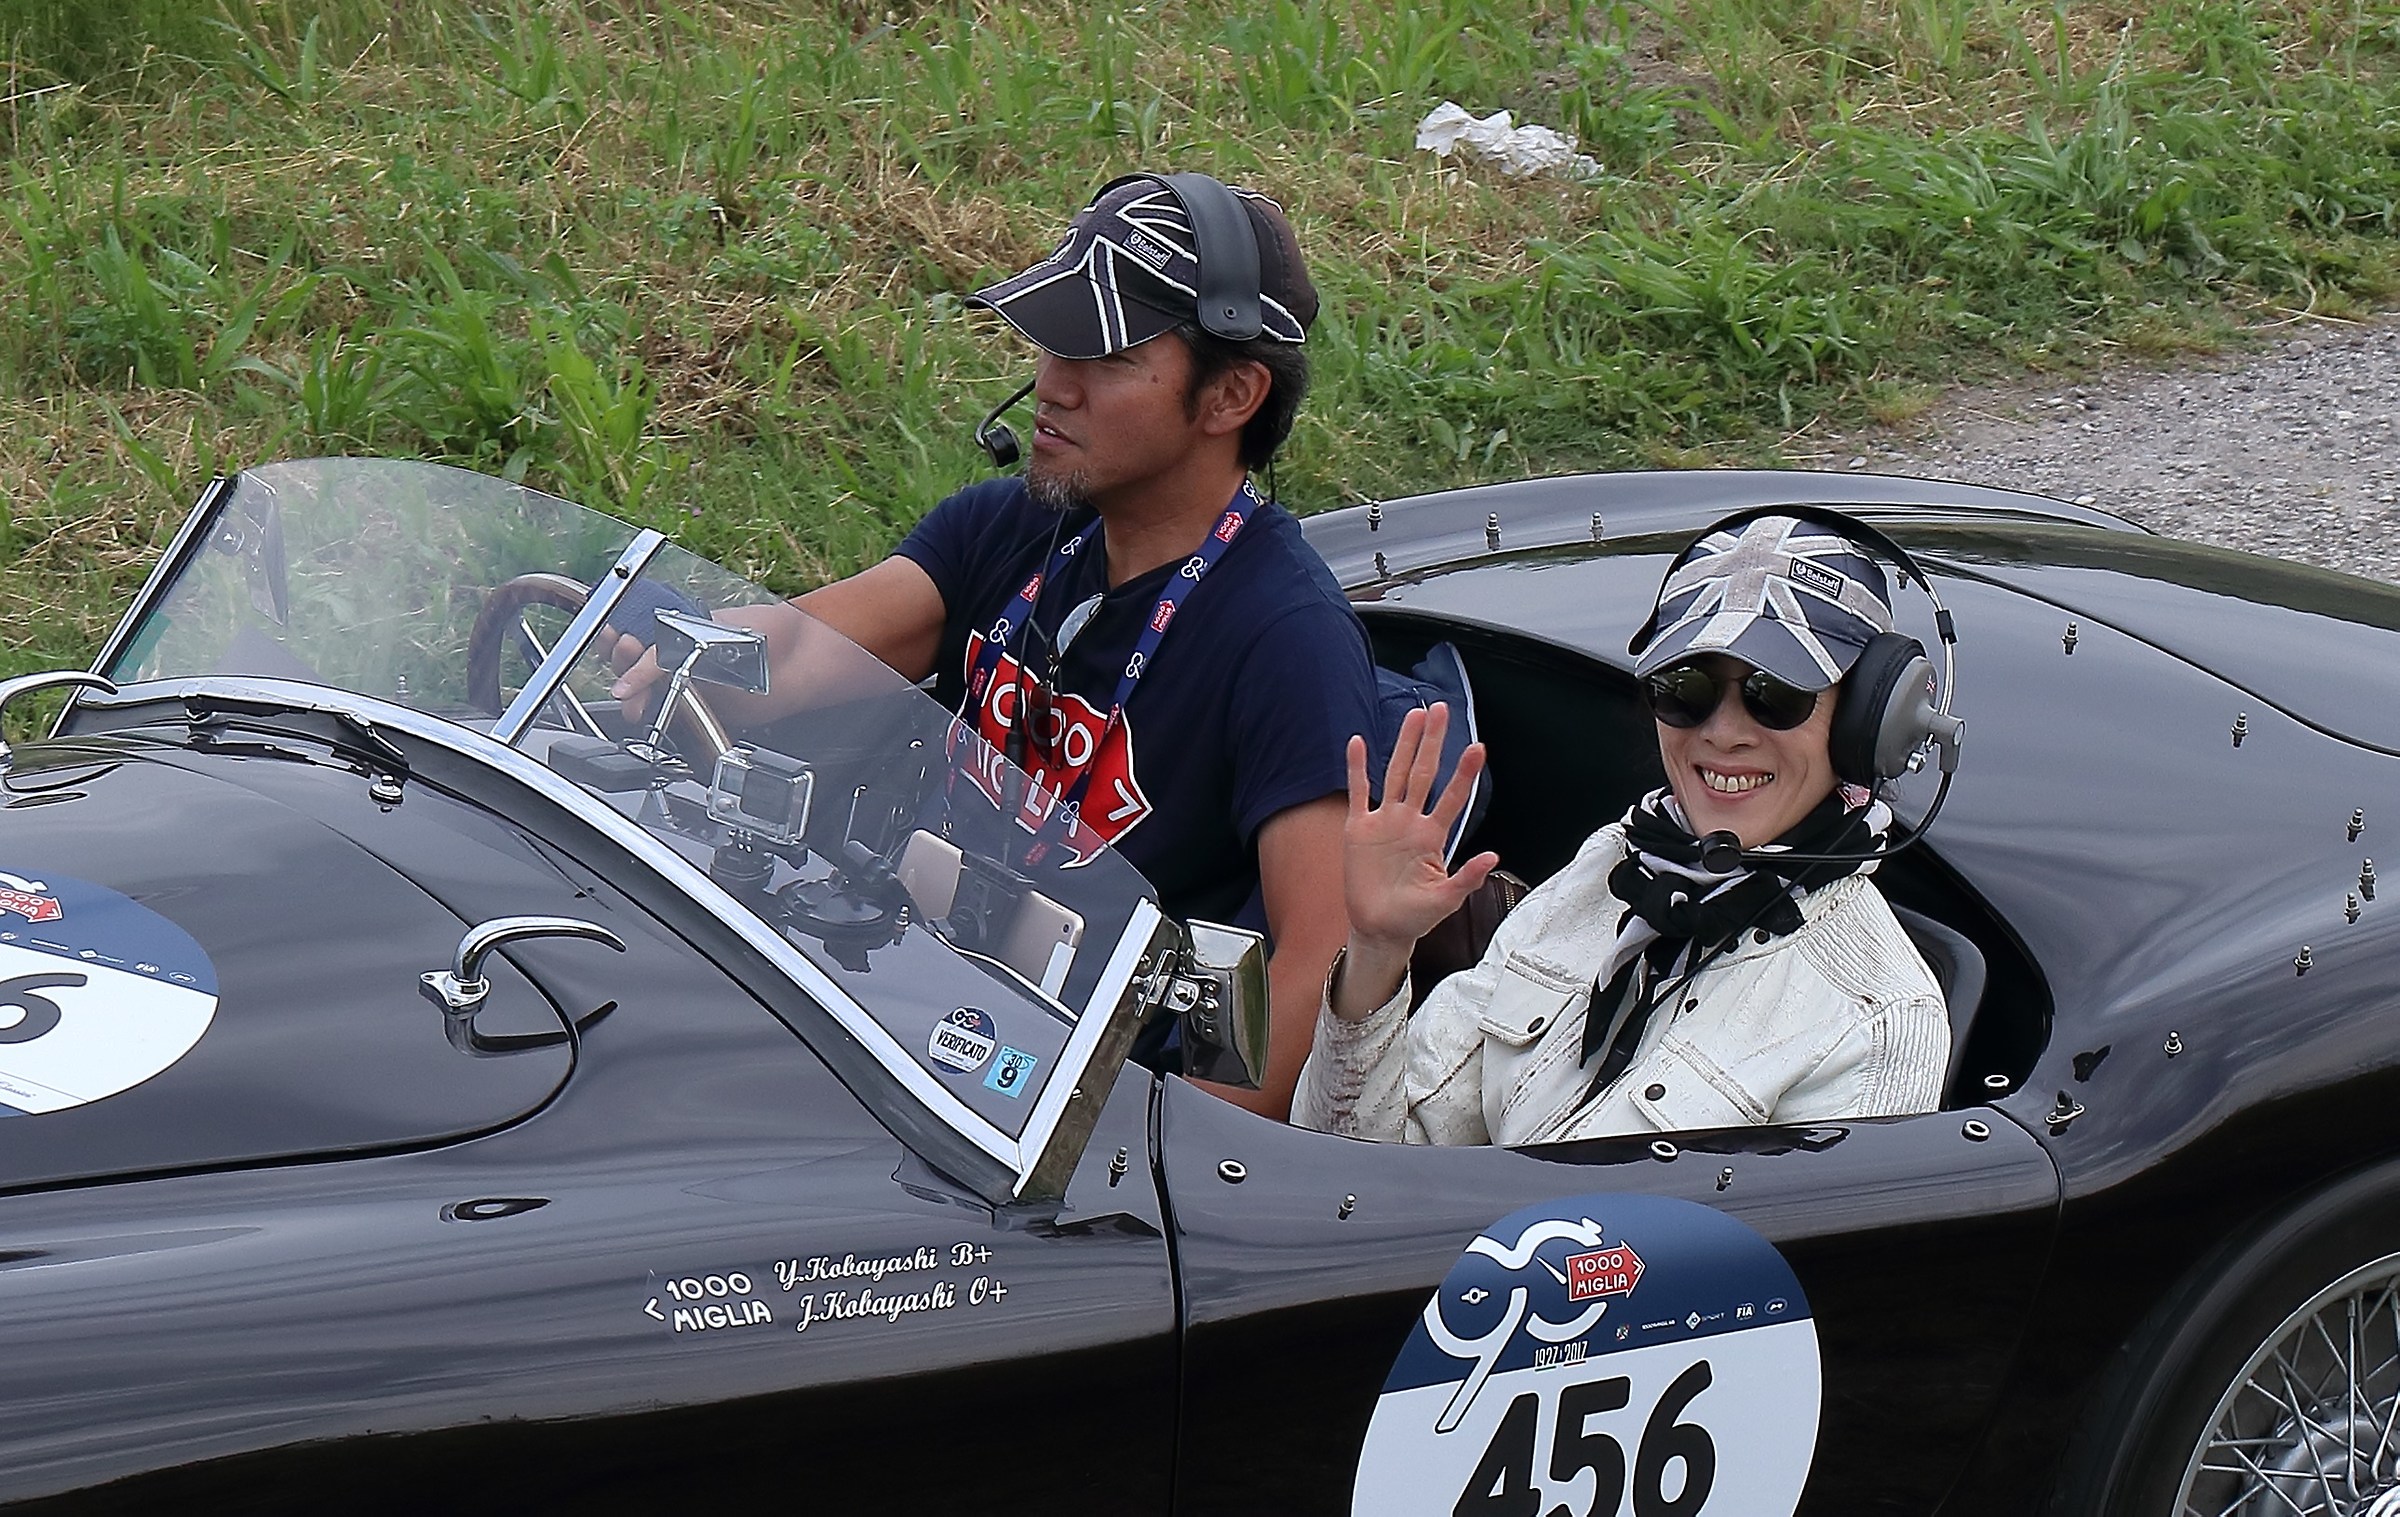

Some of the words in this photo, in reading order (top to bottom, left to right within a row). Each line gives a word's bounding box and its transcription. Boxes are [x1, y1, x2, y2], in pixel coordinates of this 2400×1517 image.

[937, 1030, 987, 1060] VERIFICATO
[1008, 1054, 1022, 1068] 30
[997, 1067, 1018, 1088] 9
[773, 1246, 939, 1292] Y.Kobayashi
[950, 1241, 994, 1267] B+
[1576, 1253, 1623, 1276] 1000
[665, 1272, 753, 1302] 1000
[1575, 1274, 1629, 1294] MIGLIA
[672, 1299, 774, 1333] MIGLIA
[796, 1280, 956, 1333] J.Kobayashi
[968, 1275, 1009, 1307] O+
[1736, 1306, 1753, 1319] FIA
[1534, 1345, 1559, 1367] 1927
[1564, 1340, 1588, 1362] 2017
[1450, 1358, 1716, 1517] 456
